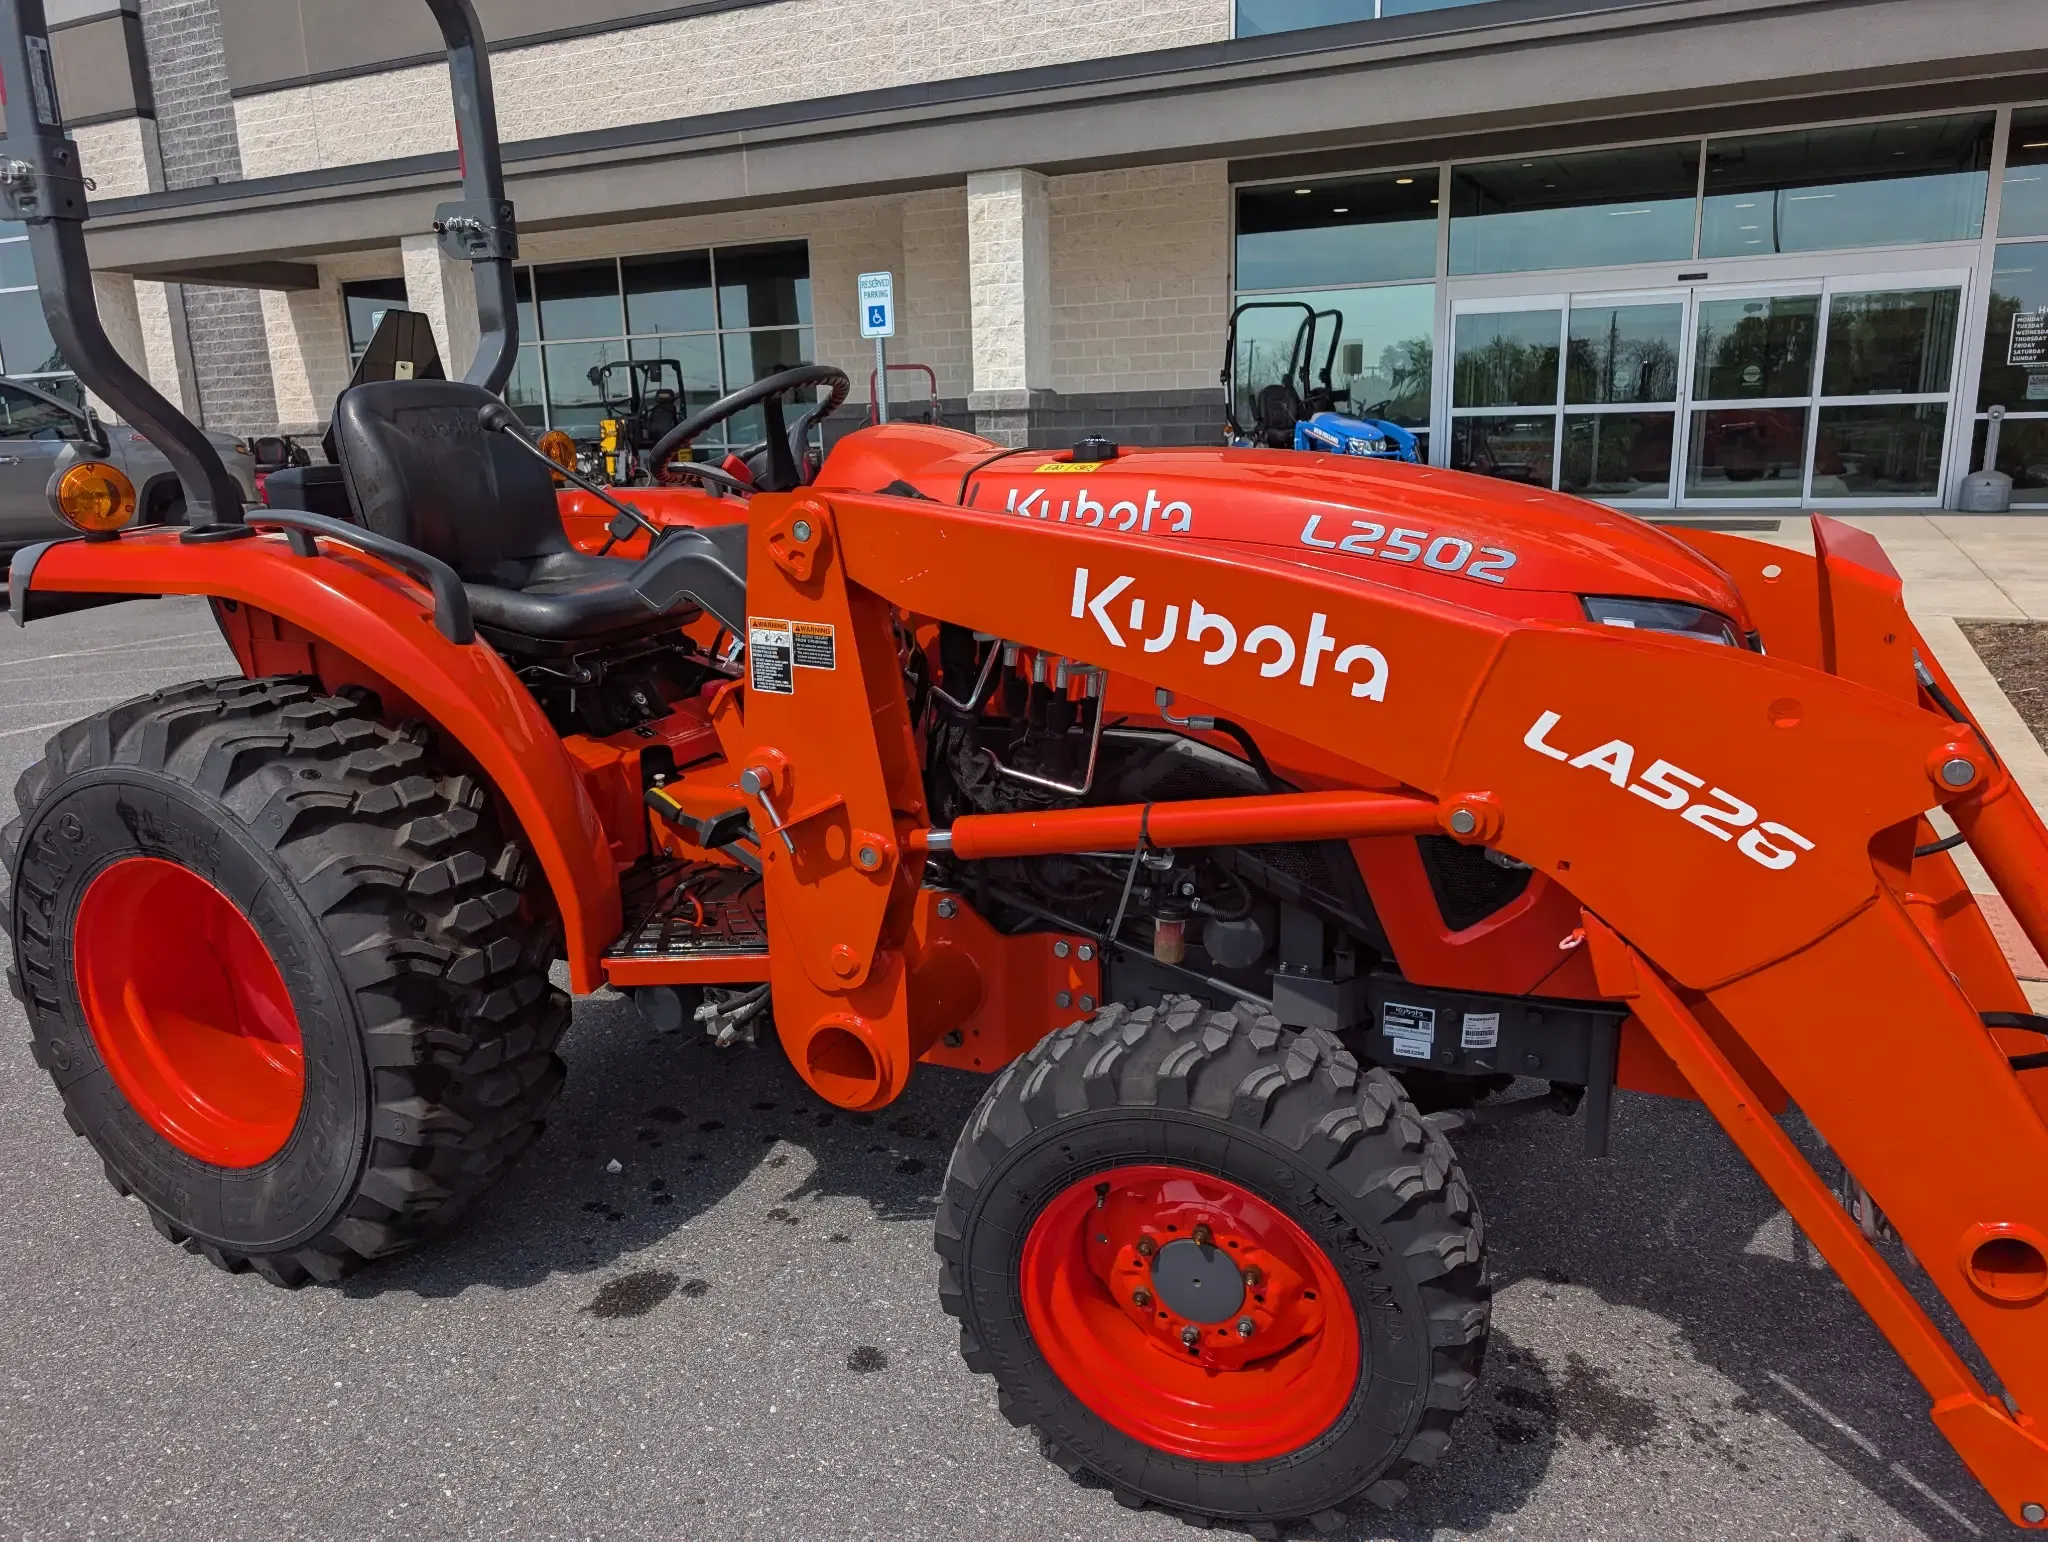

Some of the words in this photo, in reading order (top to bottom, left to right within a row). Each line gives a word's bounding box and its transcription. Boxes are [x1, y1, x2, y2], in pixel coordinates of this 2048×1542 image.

[861, 279, 889, 288] RESERVED
[864, 290, 888, 299] PARKING
[1006, 488, 1193, 532] Kubota
[1300, 514, 1518, 584] L2502
[758, 621, 787, 630] WARNING
[800, 625, 830, 634] WARNING
[1070, 567, 1389, 702] Kubota
[1523, 709, 1816, 870] LA526
[20, 827, 73, 1023] TITAN
[1395, 1007, 1424, 1016] Kubota
[1297, 1183, 1403, 1313] TITAN
